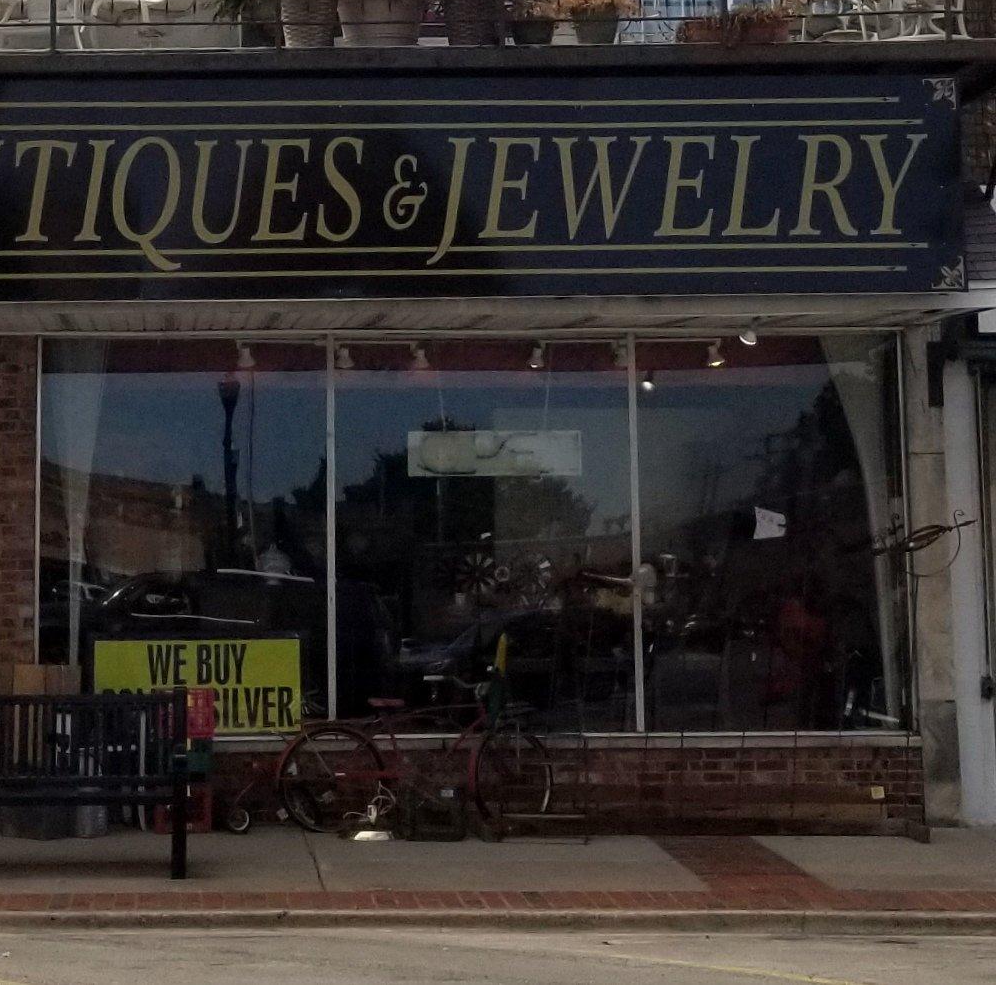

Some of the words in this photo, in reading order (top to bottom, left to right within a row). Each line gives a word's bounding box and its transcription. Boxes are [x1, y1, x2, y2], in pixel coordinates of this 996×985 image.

[382, 153, 427, 231] &
[426, 132, 929, 266] JEWELRY
[147, 643, 188, 686] WE
[196, 643, 247, 686] BUY
